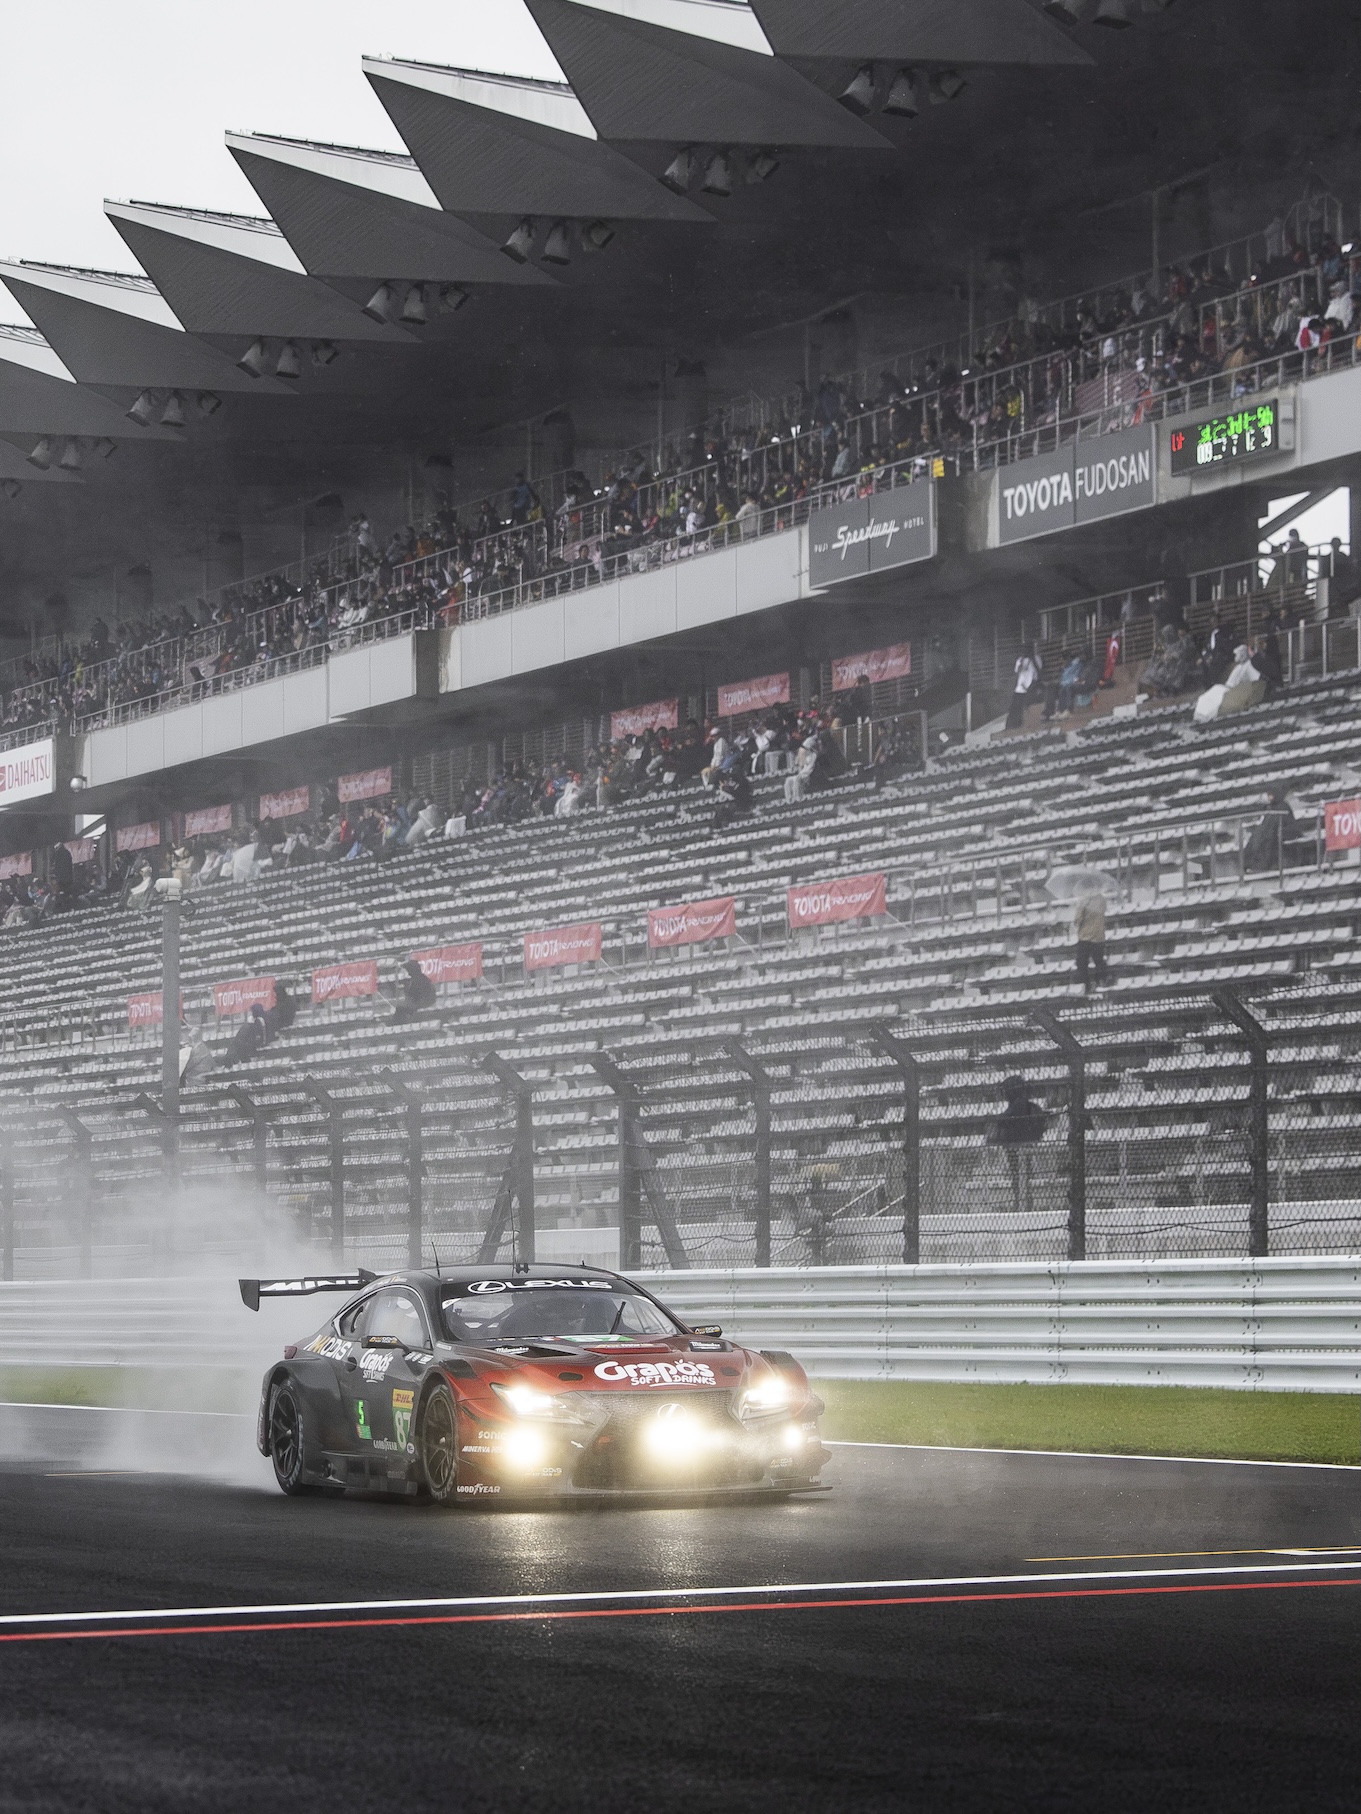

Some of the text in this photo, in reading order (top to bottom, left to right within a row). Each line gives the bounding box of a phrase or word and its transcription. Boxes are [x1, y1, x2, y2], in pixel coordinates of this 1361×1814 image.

[1003, 450, 1150, 519] TOYOTA FUDOSAN
[832, 518, 900, 560] Speedway
[7, 753, 51, 790] DAIHATSU
[794, 893, 831, 917] TOYOTA
[654, 915, 688, 937] TOYOTA
[529, 939, 559, 960] TOYOTA
[506, 1279, 613, 1289] LEXUS
[630, 1375, 717, 1386] SOFT DRINKS
[394, 1410, 412, 1450] 87
[457, 1483, 501, 1496] GOODYEAR
